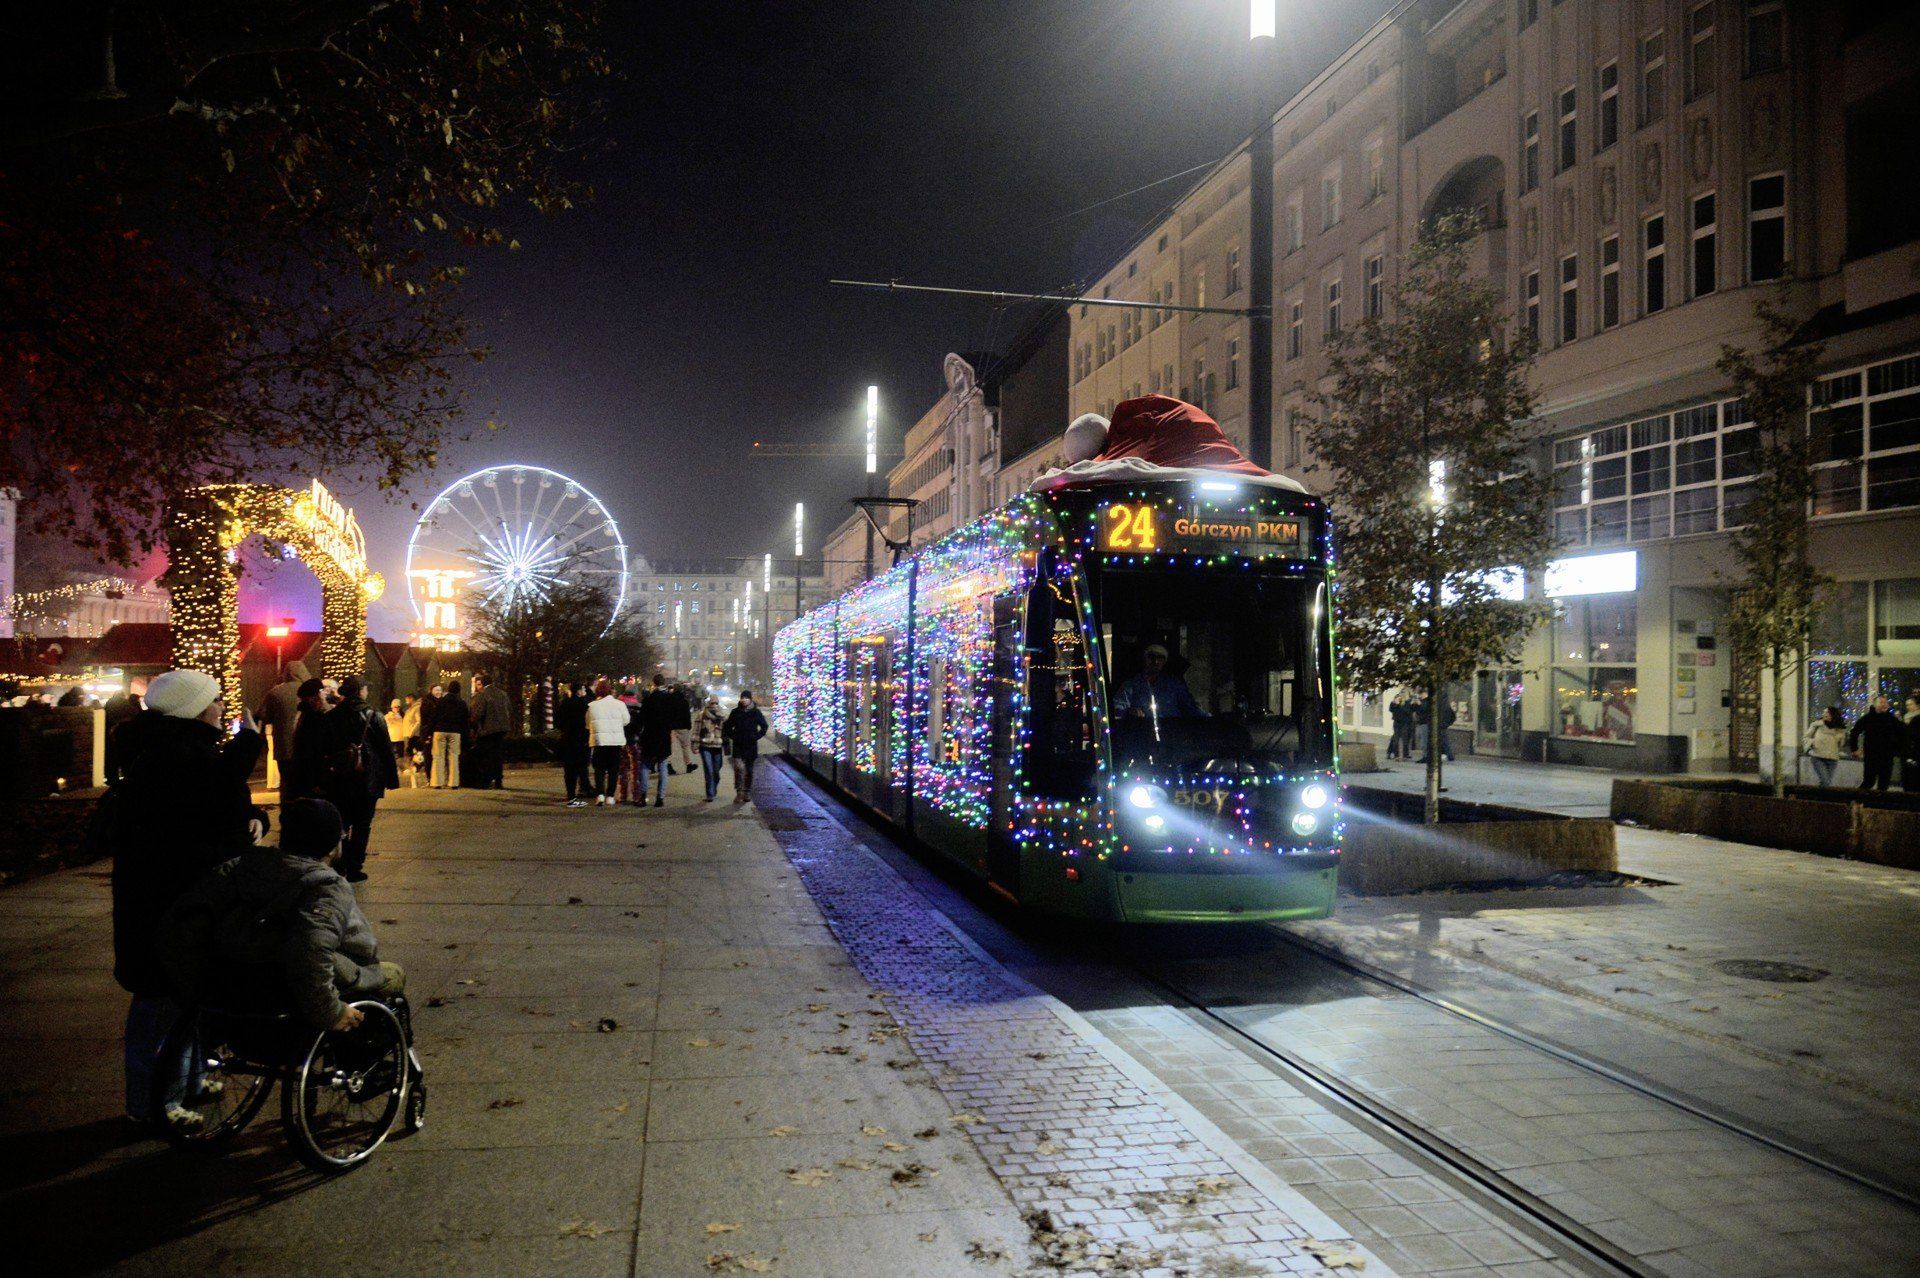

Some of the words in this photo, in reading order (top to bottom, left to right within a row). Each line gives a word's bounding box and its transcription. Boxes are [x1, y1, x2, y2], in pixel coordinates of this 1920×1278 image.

[1109, 505, 1154, 547] 24
[1174, 518, 1252, 541] Górczyn
[1257, 522, 1298, 541] PKM
